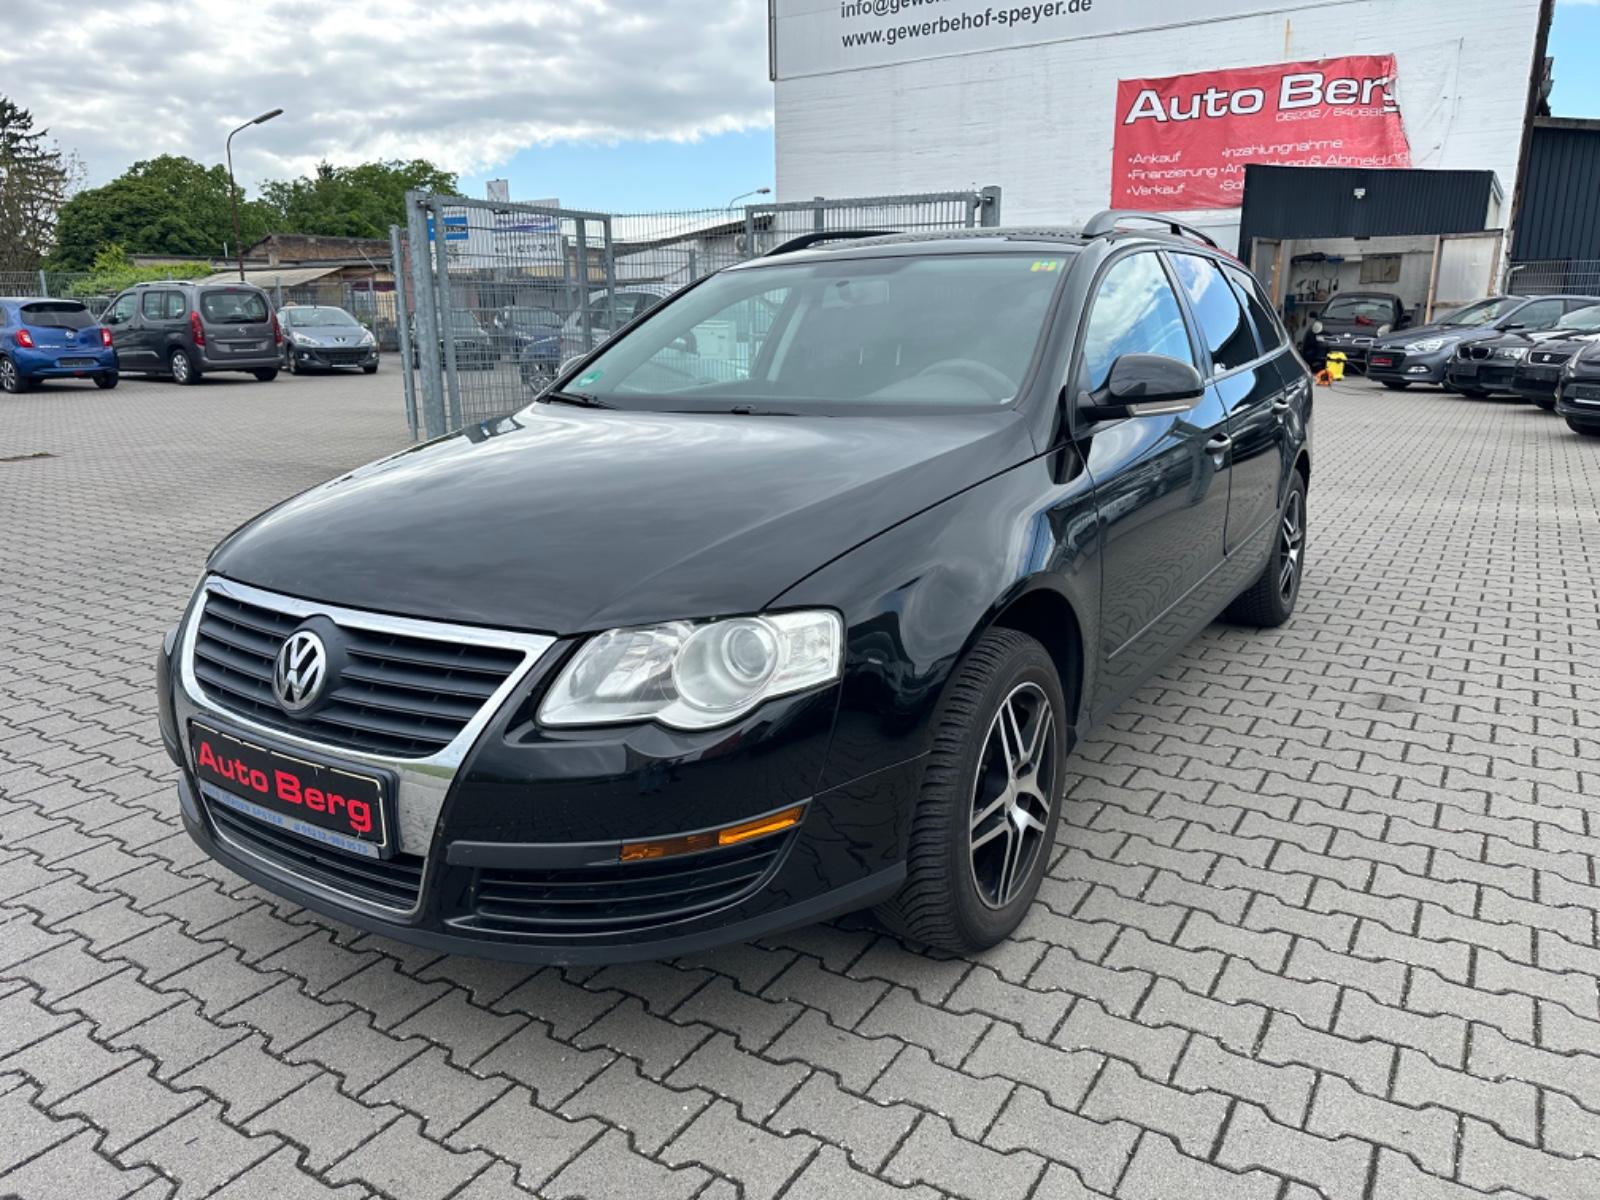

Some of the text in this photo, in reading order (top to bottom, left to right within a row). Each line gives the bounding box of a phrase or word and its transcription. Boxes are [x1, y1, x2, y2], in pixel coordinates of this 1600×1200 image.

[842, 0, 1092, 47] www.gewerbehof-speyer.de
[1122, 87, 1266, 125] Auto
[1132, 151, 1181, 164] Ankauf
[1131, 167, 1218, 180] Finanzierung
[1131, 183, 1186, 196] Verkauf
[199, 741, 270, 794] Auto
[275, 768, 372, 833] Berg
